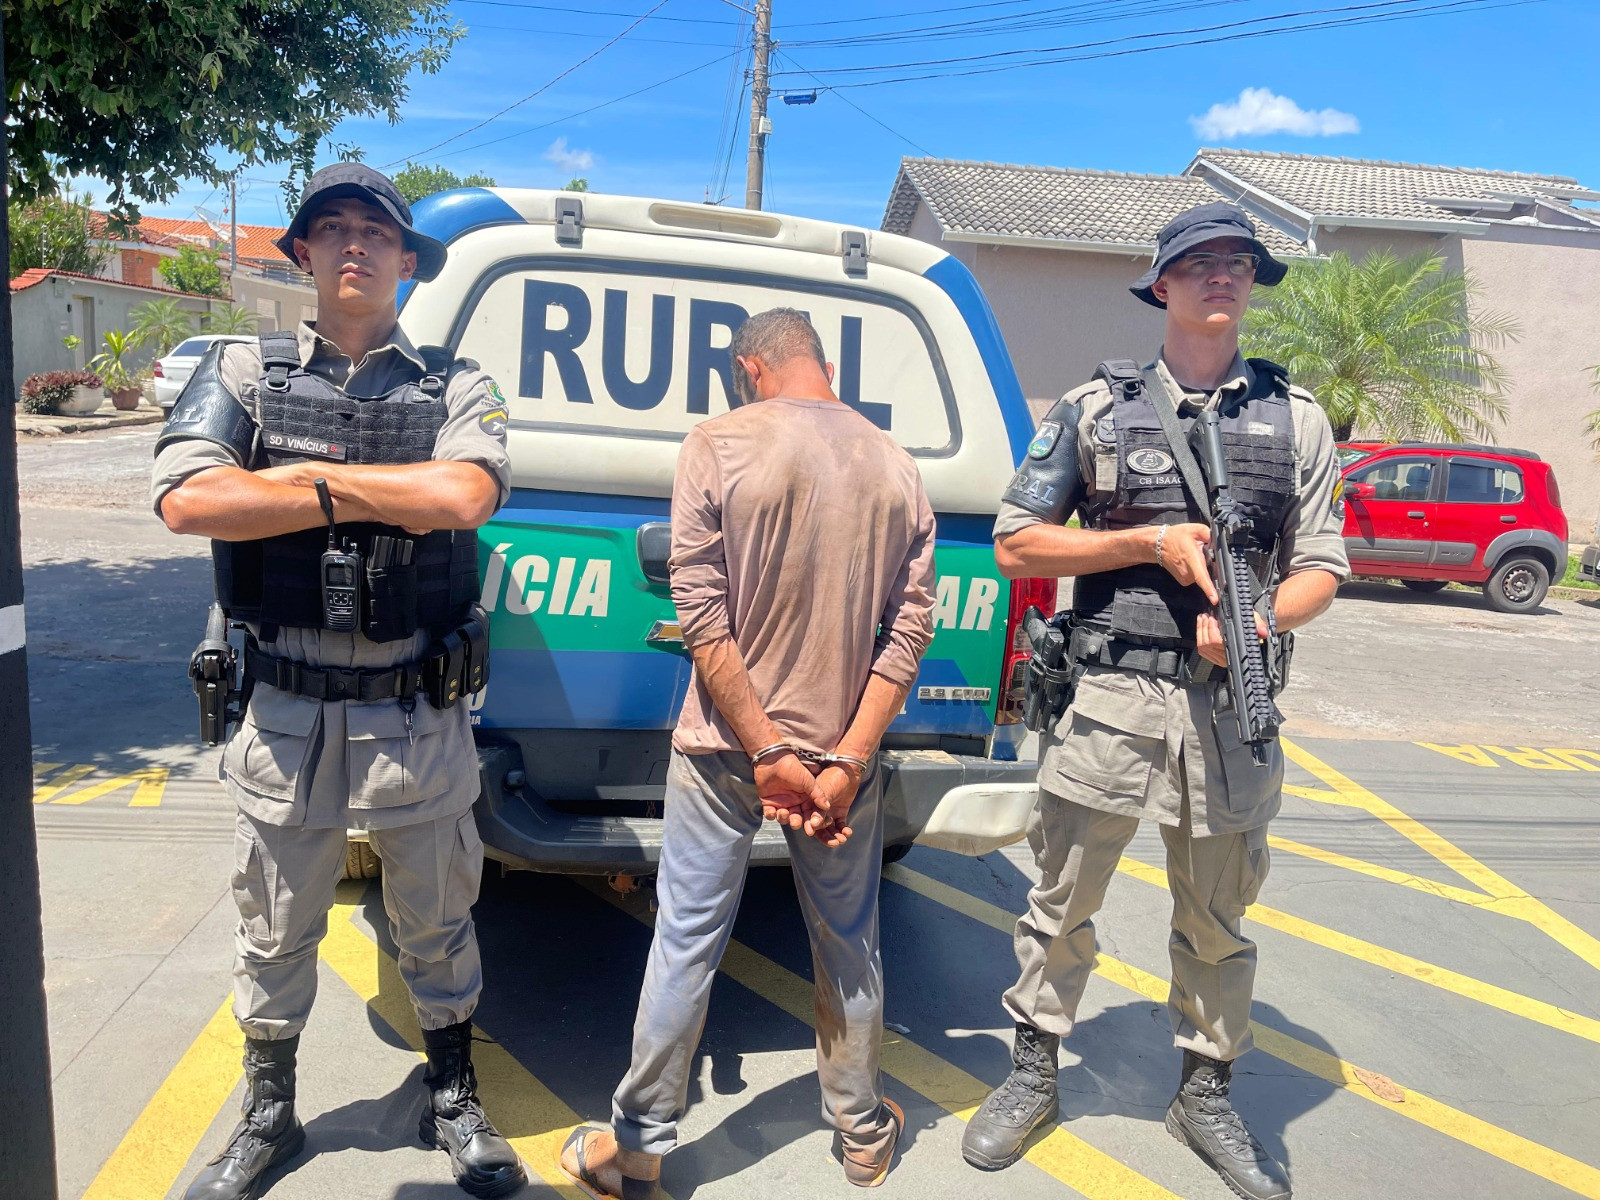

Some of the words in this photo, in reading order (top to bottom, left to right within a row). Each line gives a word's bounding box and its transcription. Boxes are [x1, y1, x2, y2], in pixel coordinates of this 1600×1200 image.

[519, 278, 892, 431] RURL
[269, 435, 283, 446] SD
[287, 437, 328, 454] VINÍCIUS
[1139, 477, 1152, 486] CB
[1156, 476, 1184, 485] ISAAC
